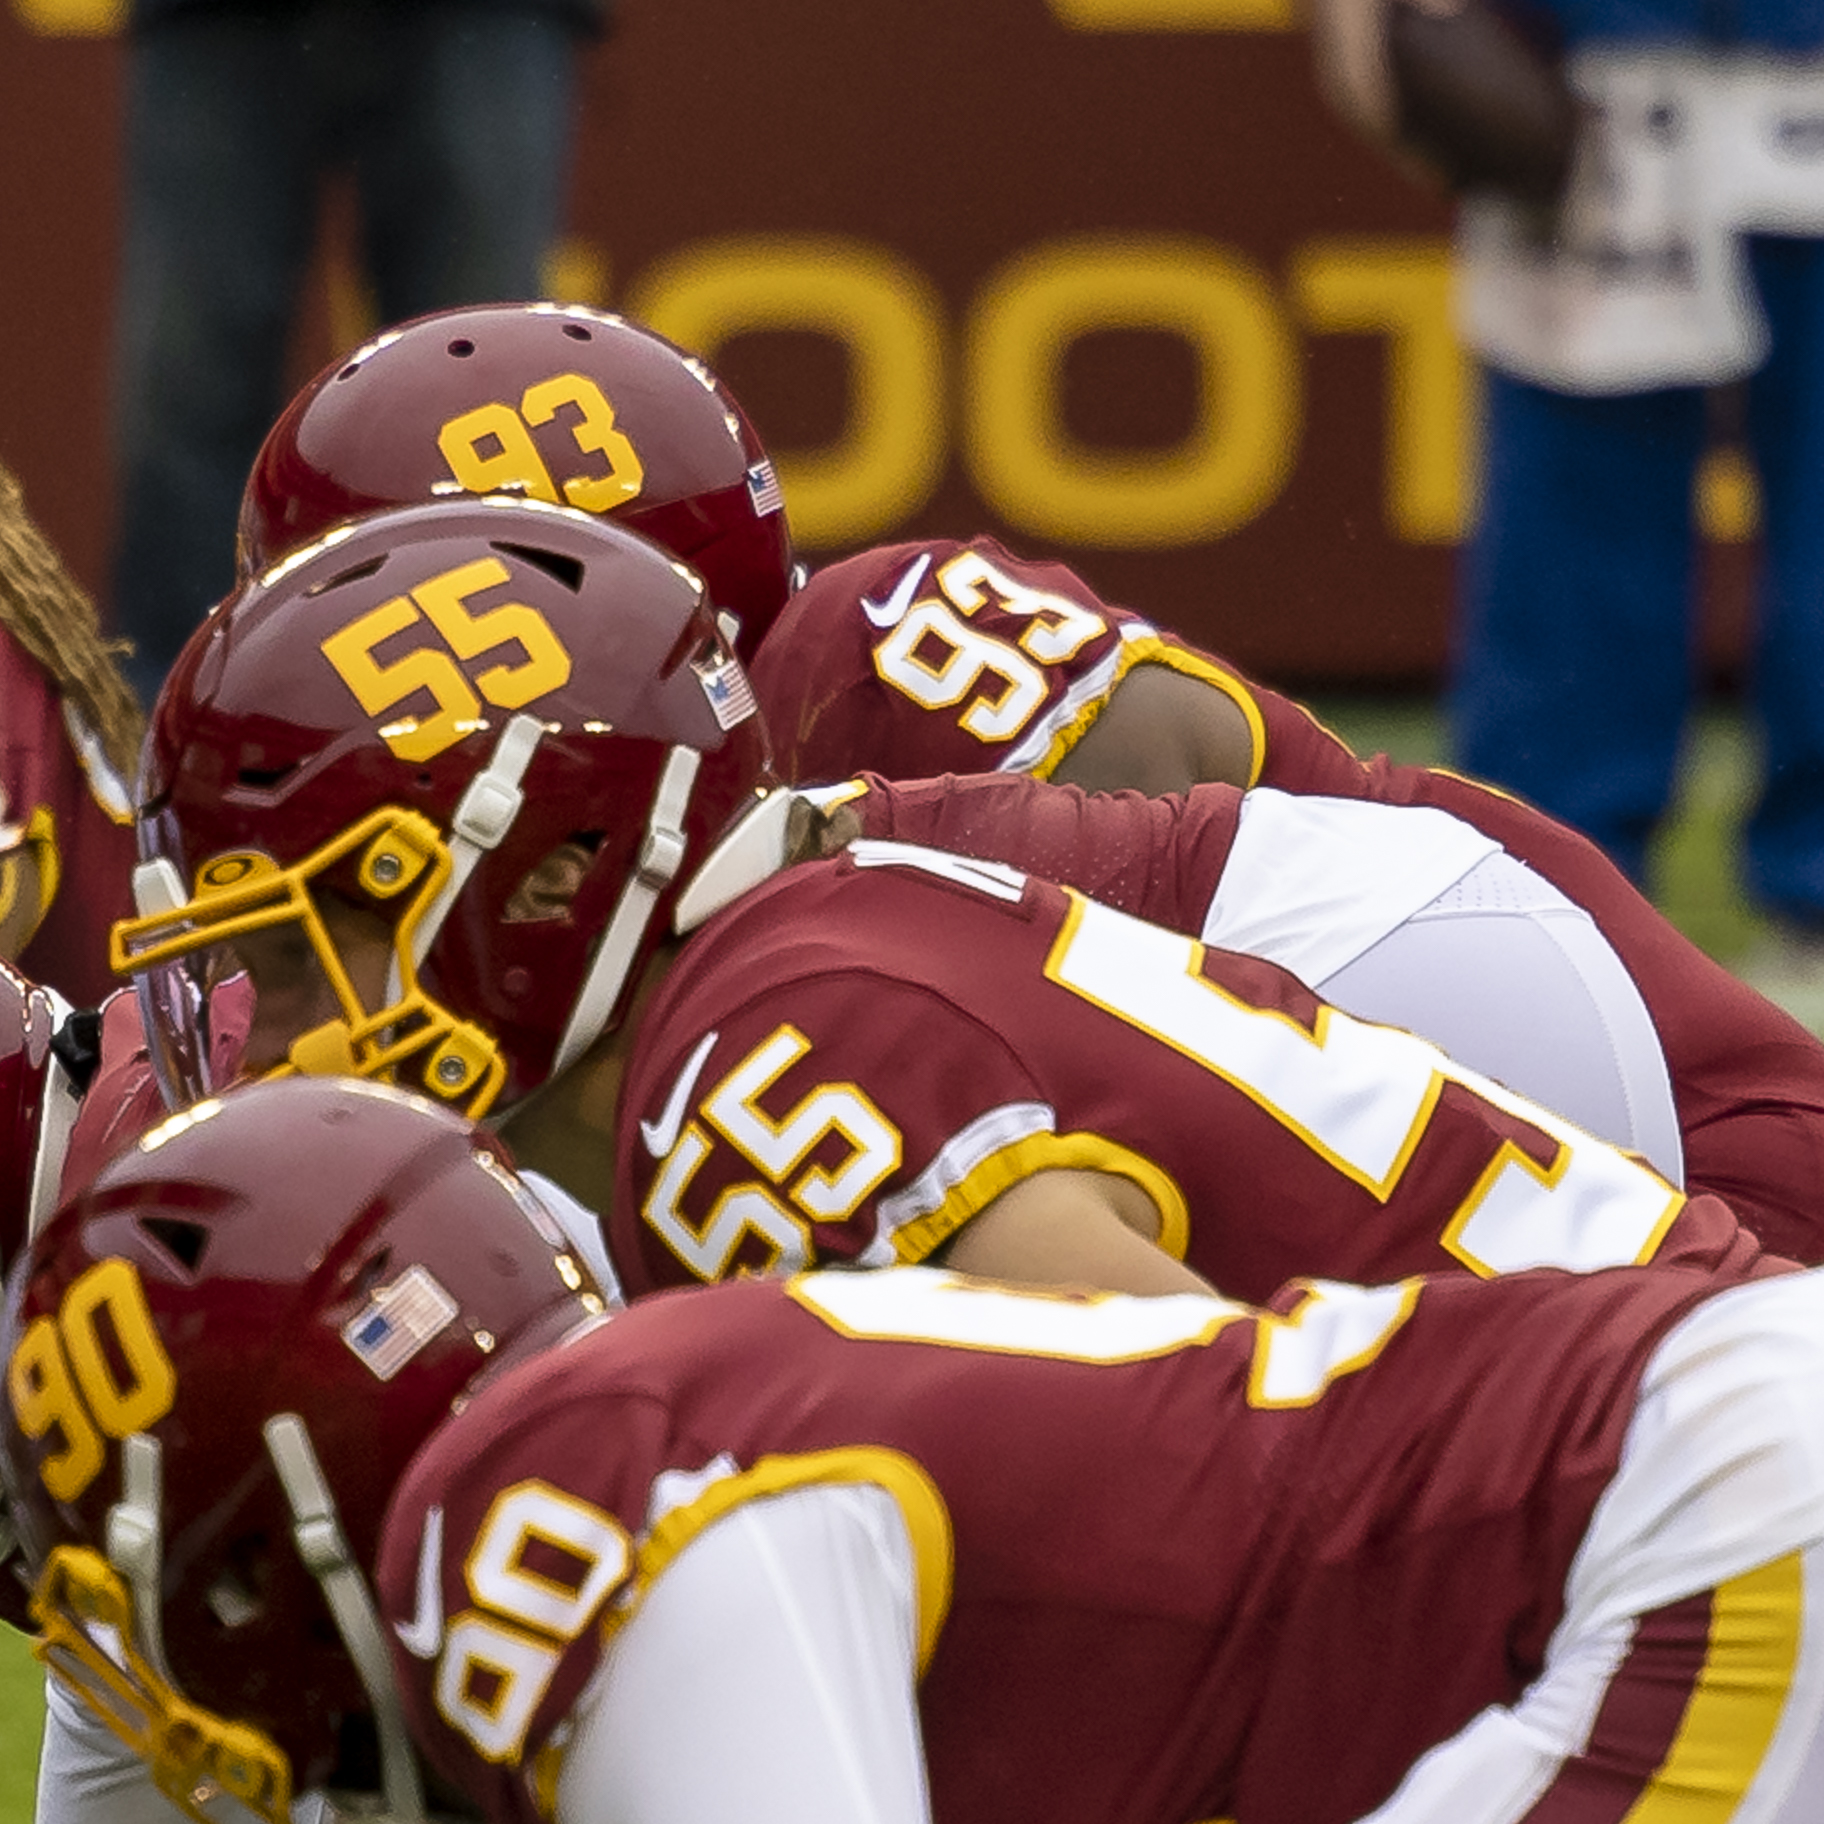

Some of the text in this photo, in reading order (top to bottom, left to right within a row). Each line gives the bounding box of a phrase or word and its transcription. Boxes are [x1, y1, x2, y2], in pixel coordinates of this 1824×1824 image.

[438, 373, 644, 513] 93
[321, 557, 572, 763] 55
[873, 550, 1108, 744] 93
[641, 1020, 903, 1285] 55
[7, 1256, 177, 1502] 90
[434, 1477, 636, 1767] 90
